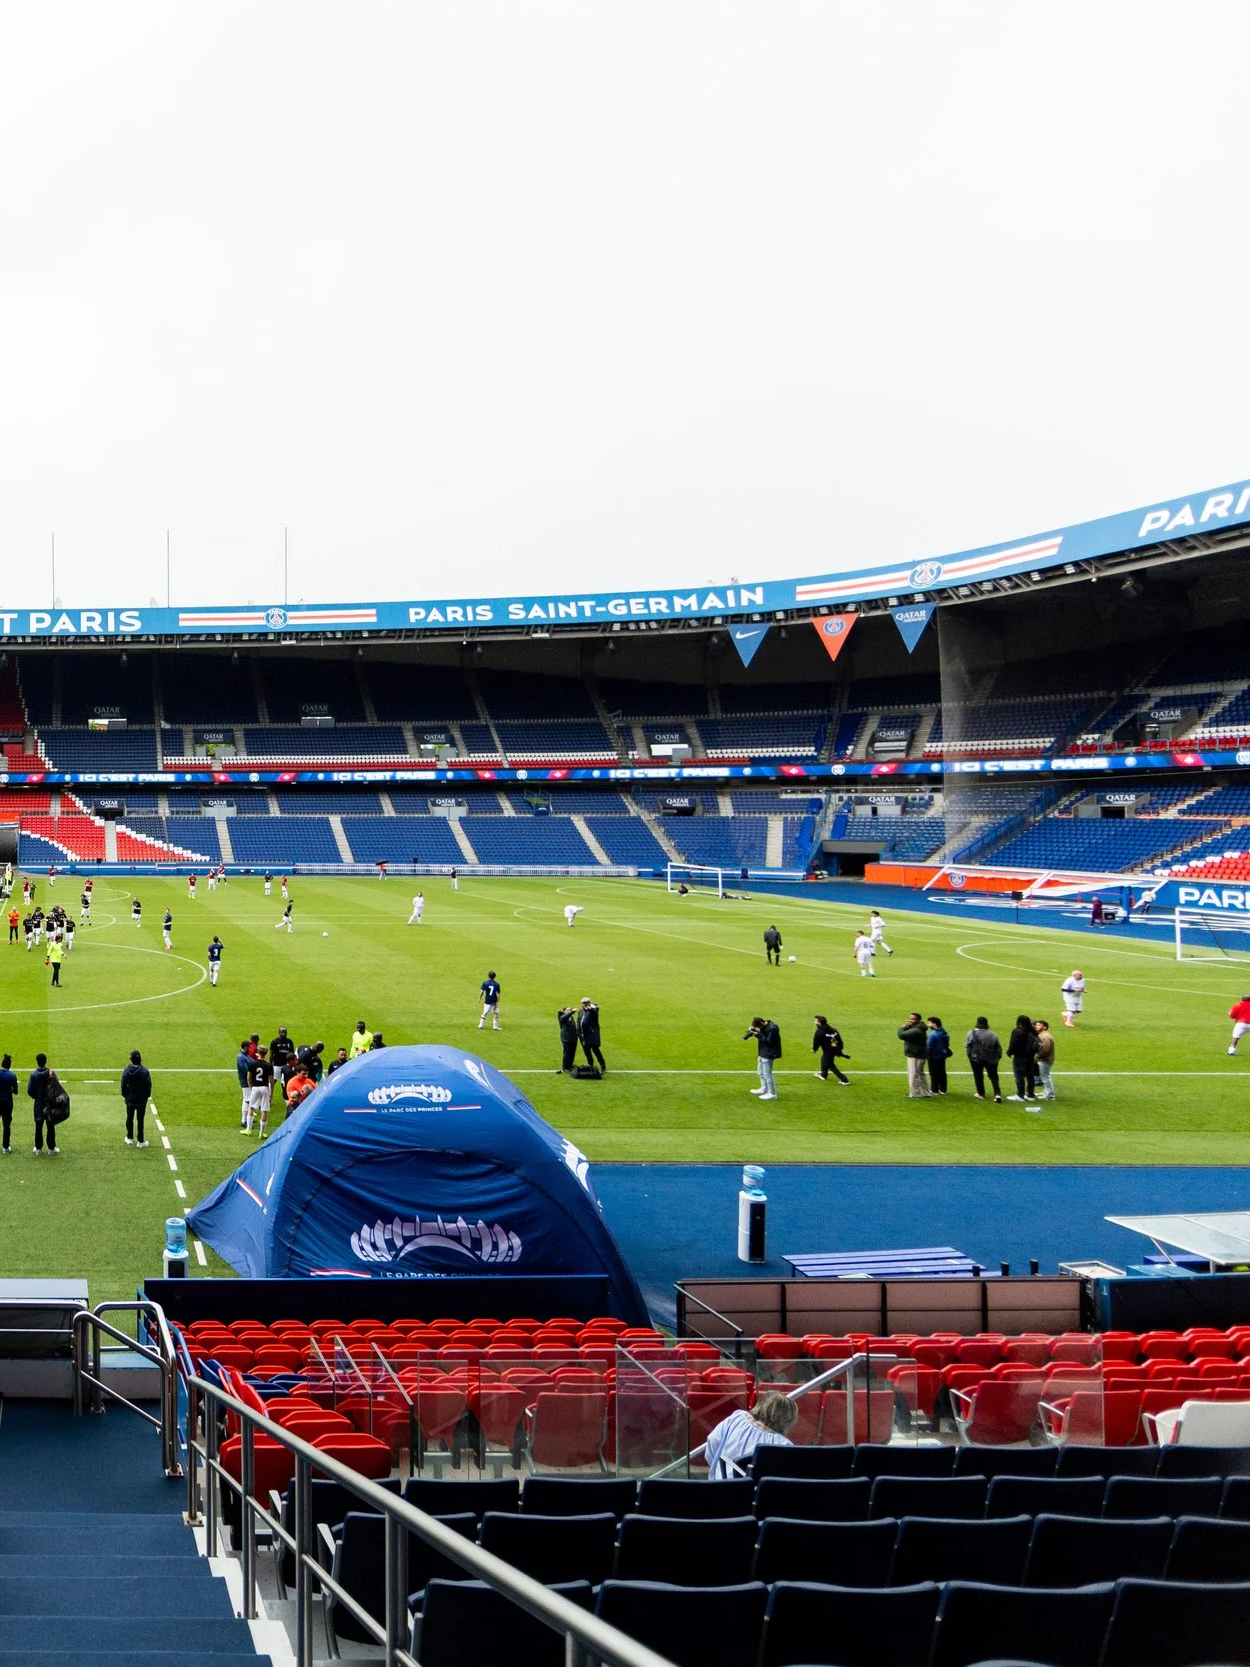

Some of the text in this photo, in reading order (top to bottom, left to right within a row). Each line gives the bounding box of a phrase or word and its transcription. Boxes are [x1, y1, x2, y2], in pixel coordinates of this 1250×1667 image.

[409, 587, 764, 623] PARIS SAINT-GERMAIN
[895, 610, 926, 620] QATAR
[29, 611, 142, 633] PARIS
[1150, 710, 1181, 719] QATAR
[1051, 758, 1109, 769] PARIS
[395, 772, 435, 780] PARIS
[682, 768, 730, 777] PARIS
[138, 774, 175, 782] PARIS
[1179, 887, 1250, 909] PARI
[213, 948, 218, 957] 3
[488, 985, 494, 996] 7
[255, 1067, 263, 1081] 2
